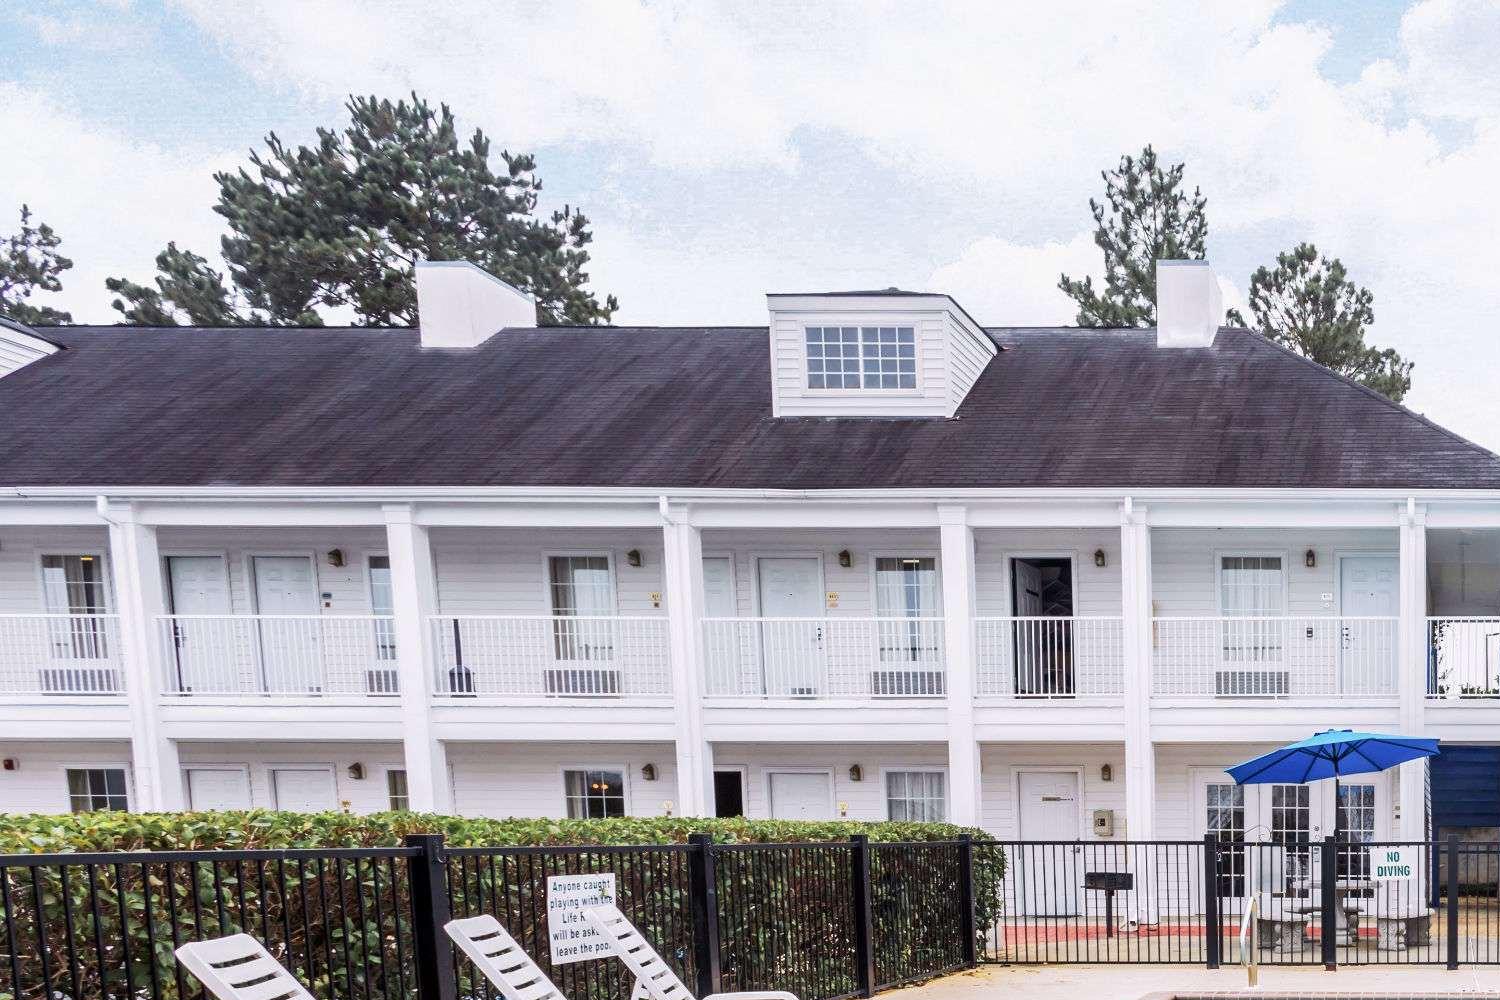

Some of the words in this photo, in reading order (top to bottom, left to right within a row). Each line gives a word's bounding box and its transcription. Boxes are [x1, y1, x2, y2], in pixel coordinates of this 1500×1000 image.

[1386, 851, 1400, 862] NO
[1377, 865, 1410, 877] DIVING
[552, 881, 581, 894] Anyone
[583, 879, 610, 892] caught
[550, 897, 579, 911] playing
[581, 895, 599, 906] with
[562, 912, 577, 924] Life
[553, 929, 568, 941] will
[571, 929, 579, 939] be
[582, 927, 600, 937] ask
[556, 947, 578, 957] leave
[581, 943, 593, 954] the
[595, 941, 612, 953] poo
